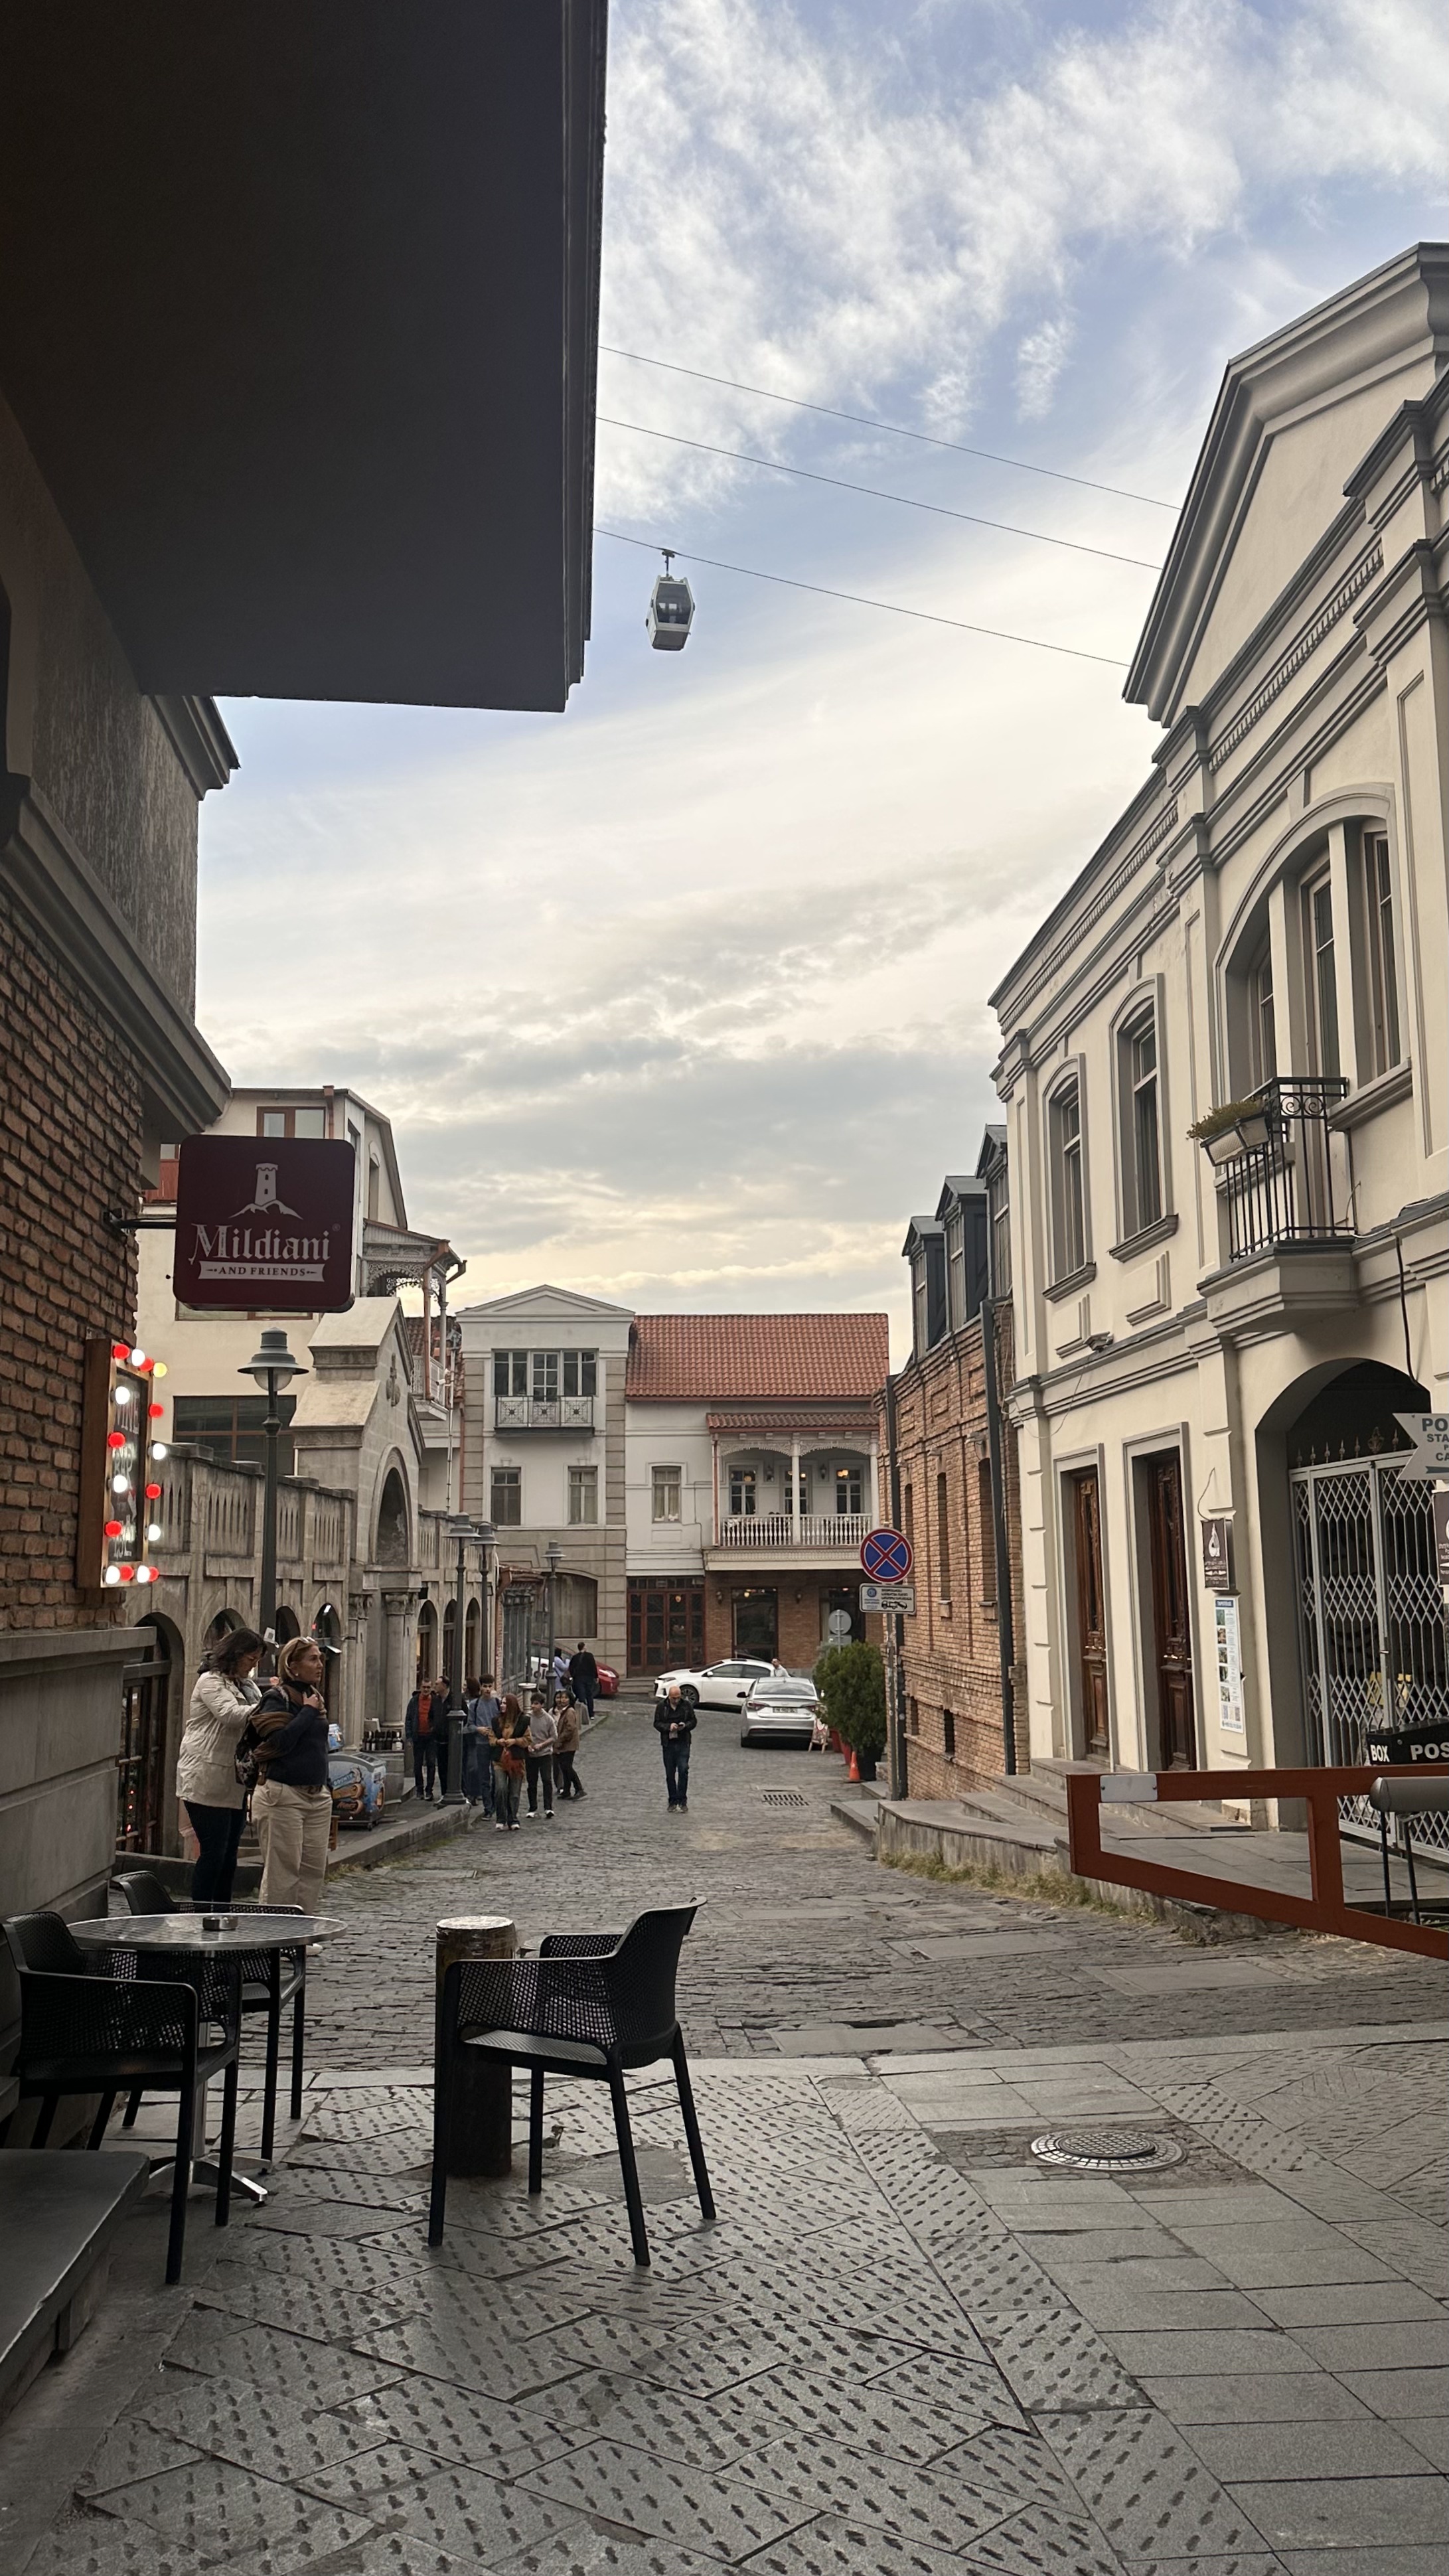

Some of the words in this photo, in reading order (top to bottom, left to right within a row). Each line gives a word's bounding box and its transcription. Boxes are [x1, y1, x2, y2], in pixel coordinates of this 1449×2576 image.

[188, 1223, 331, 1265] Mildiani
[218, 1266, 246, 1275] AND
[250, 1268, 305, 1276] FRIENDS
[1370, 1744, 1390, 1762] BOX
